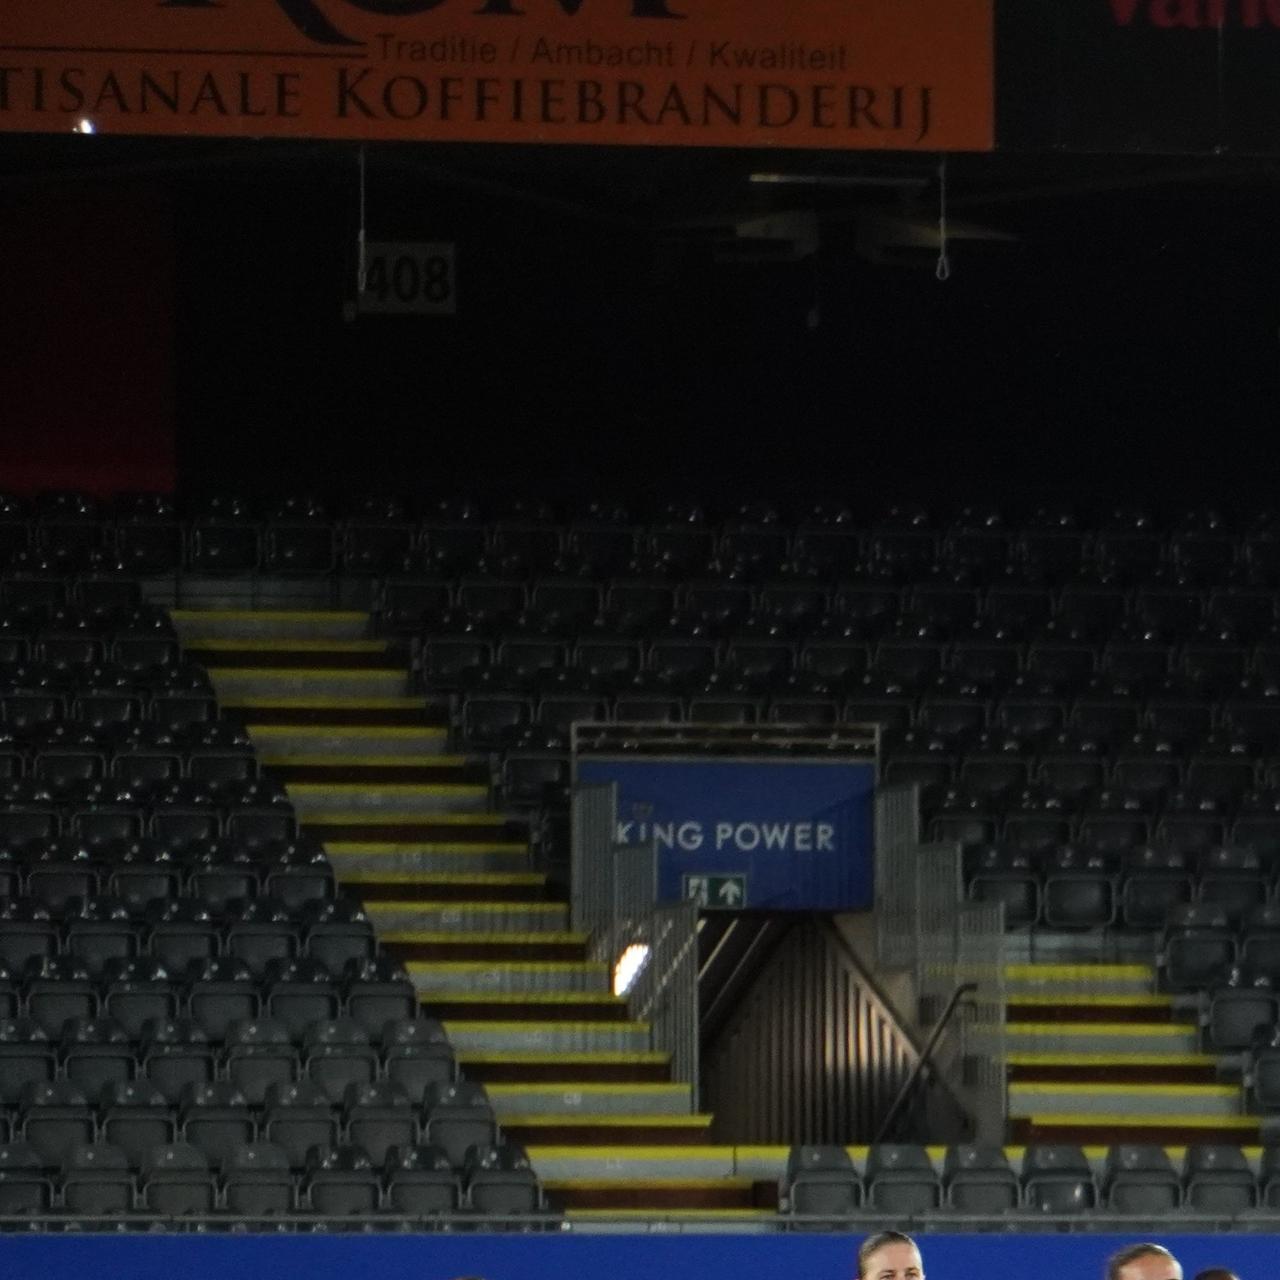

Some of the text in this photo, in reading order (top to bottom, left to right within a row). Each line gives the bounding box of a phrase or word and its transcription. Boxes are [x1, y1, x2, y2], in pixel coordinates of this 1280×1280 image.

[374, 33, 496, 64] Traditie
[531, 37, 674, 68] Ambacht
[709, 41, 849, 72] Kwaliteit
[336, 66, 934, 142] KOFFIEBRANDERIJ
[366, 256, 451, 302] 408
[615, 820, 834, 851] KING POWER
